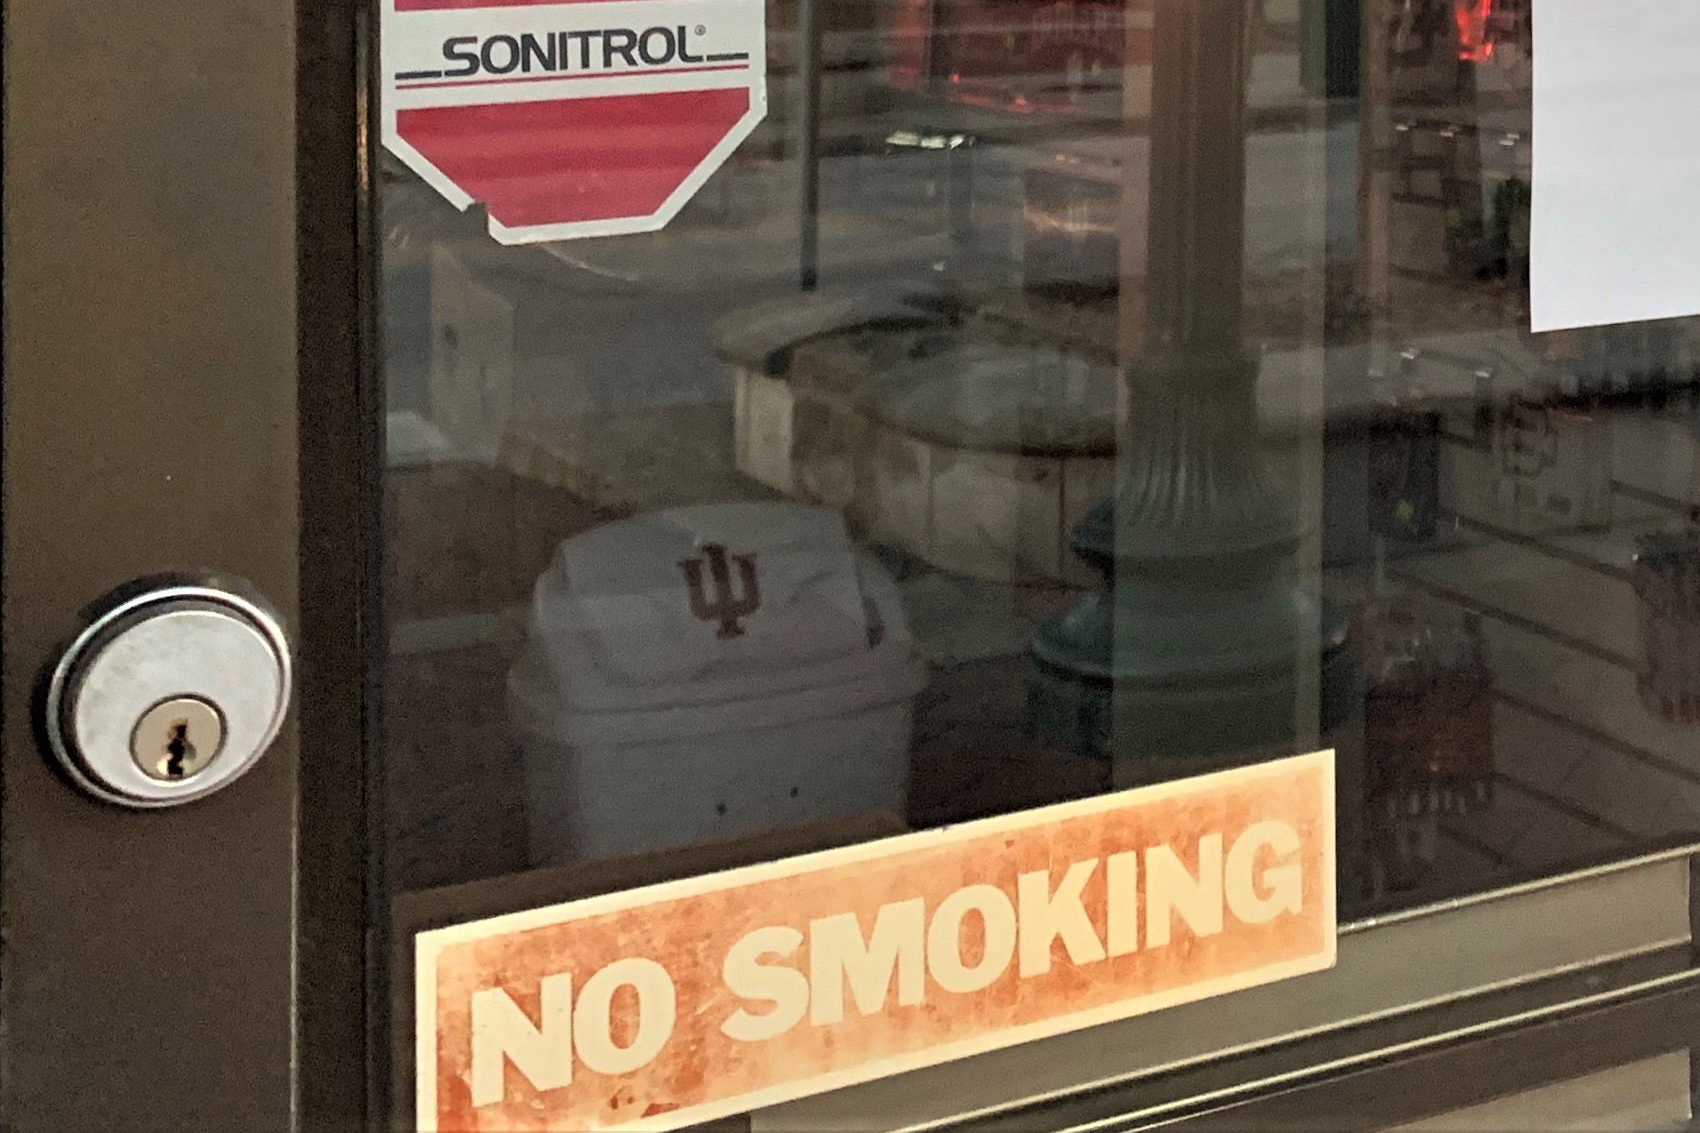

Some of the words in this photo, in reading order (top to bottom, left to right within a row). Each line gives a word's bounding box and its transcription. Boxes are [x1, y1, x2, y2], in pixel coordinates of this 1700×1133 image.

[442, 25, 706, 78] SONITROL
[469, 956, 677, 1108] NO
[719, 818, 1305, 1043] SMOKING
